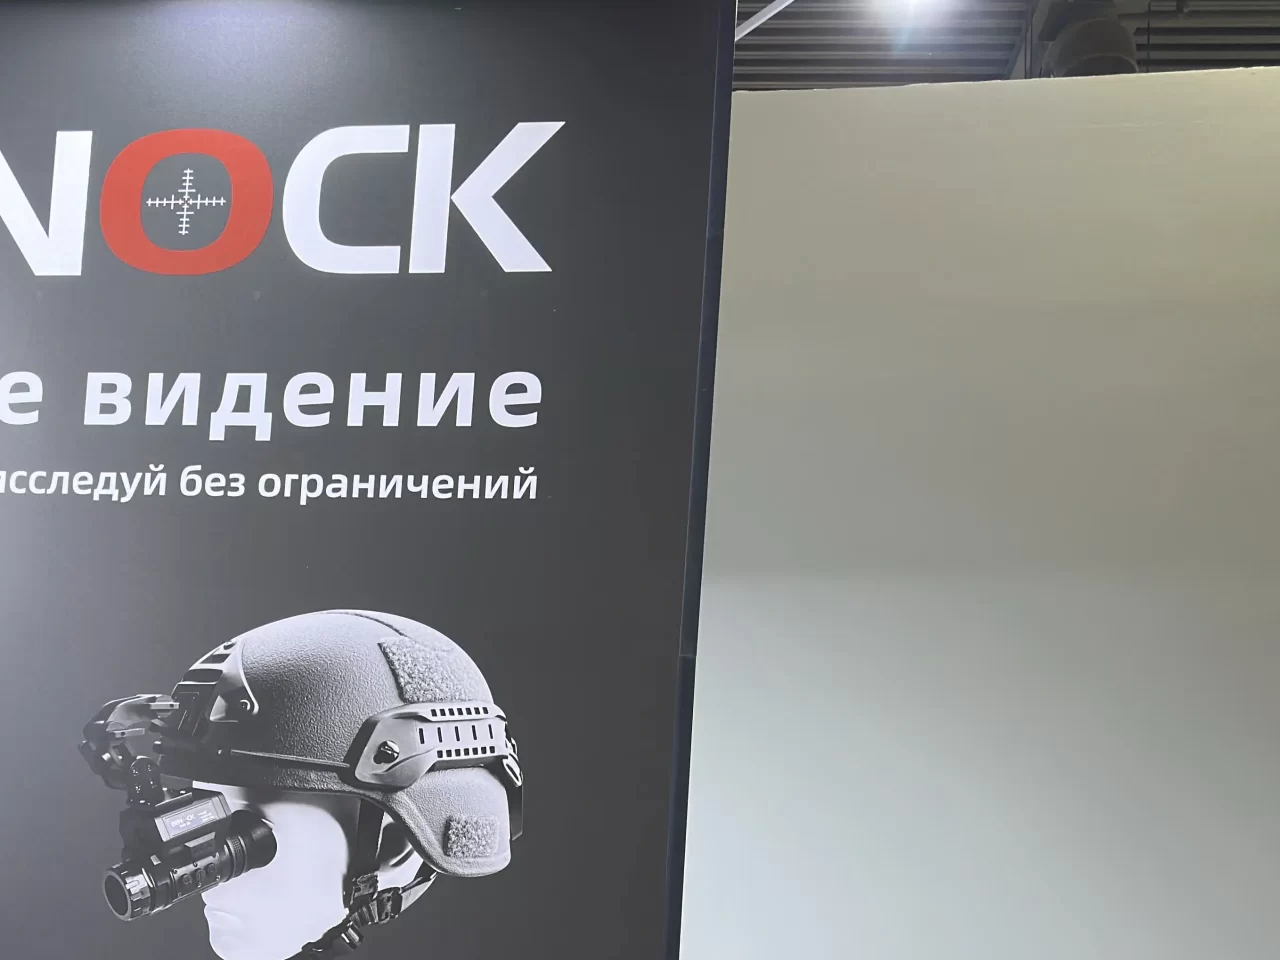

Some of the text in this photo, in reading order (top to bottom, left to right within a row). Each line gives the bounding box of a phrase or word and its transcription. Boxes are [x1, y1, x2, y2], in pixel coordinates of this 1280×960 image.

[84, 370, 542, 441] видение
[180, 465, 246, 497] без
[258, 466, 538, 505] ограничений
